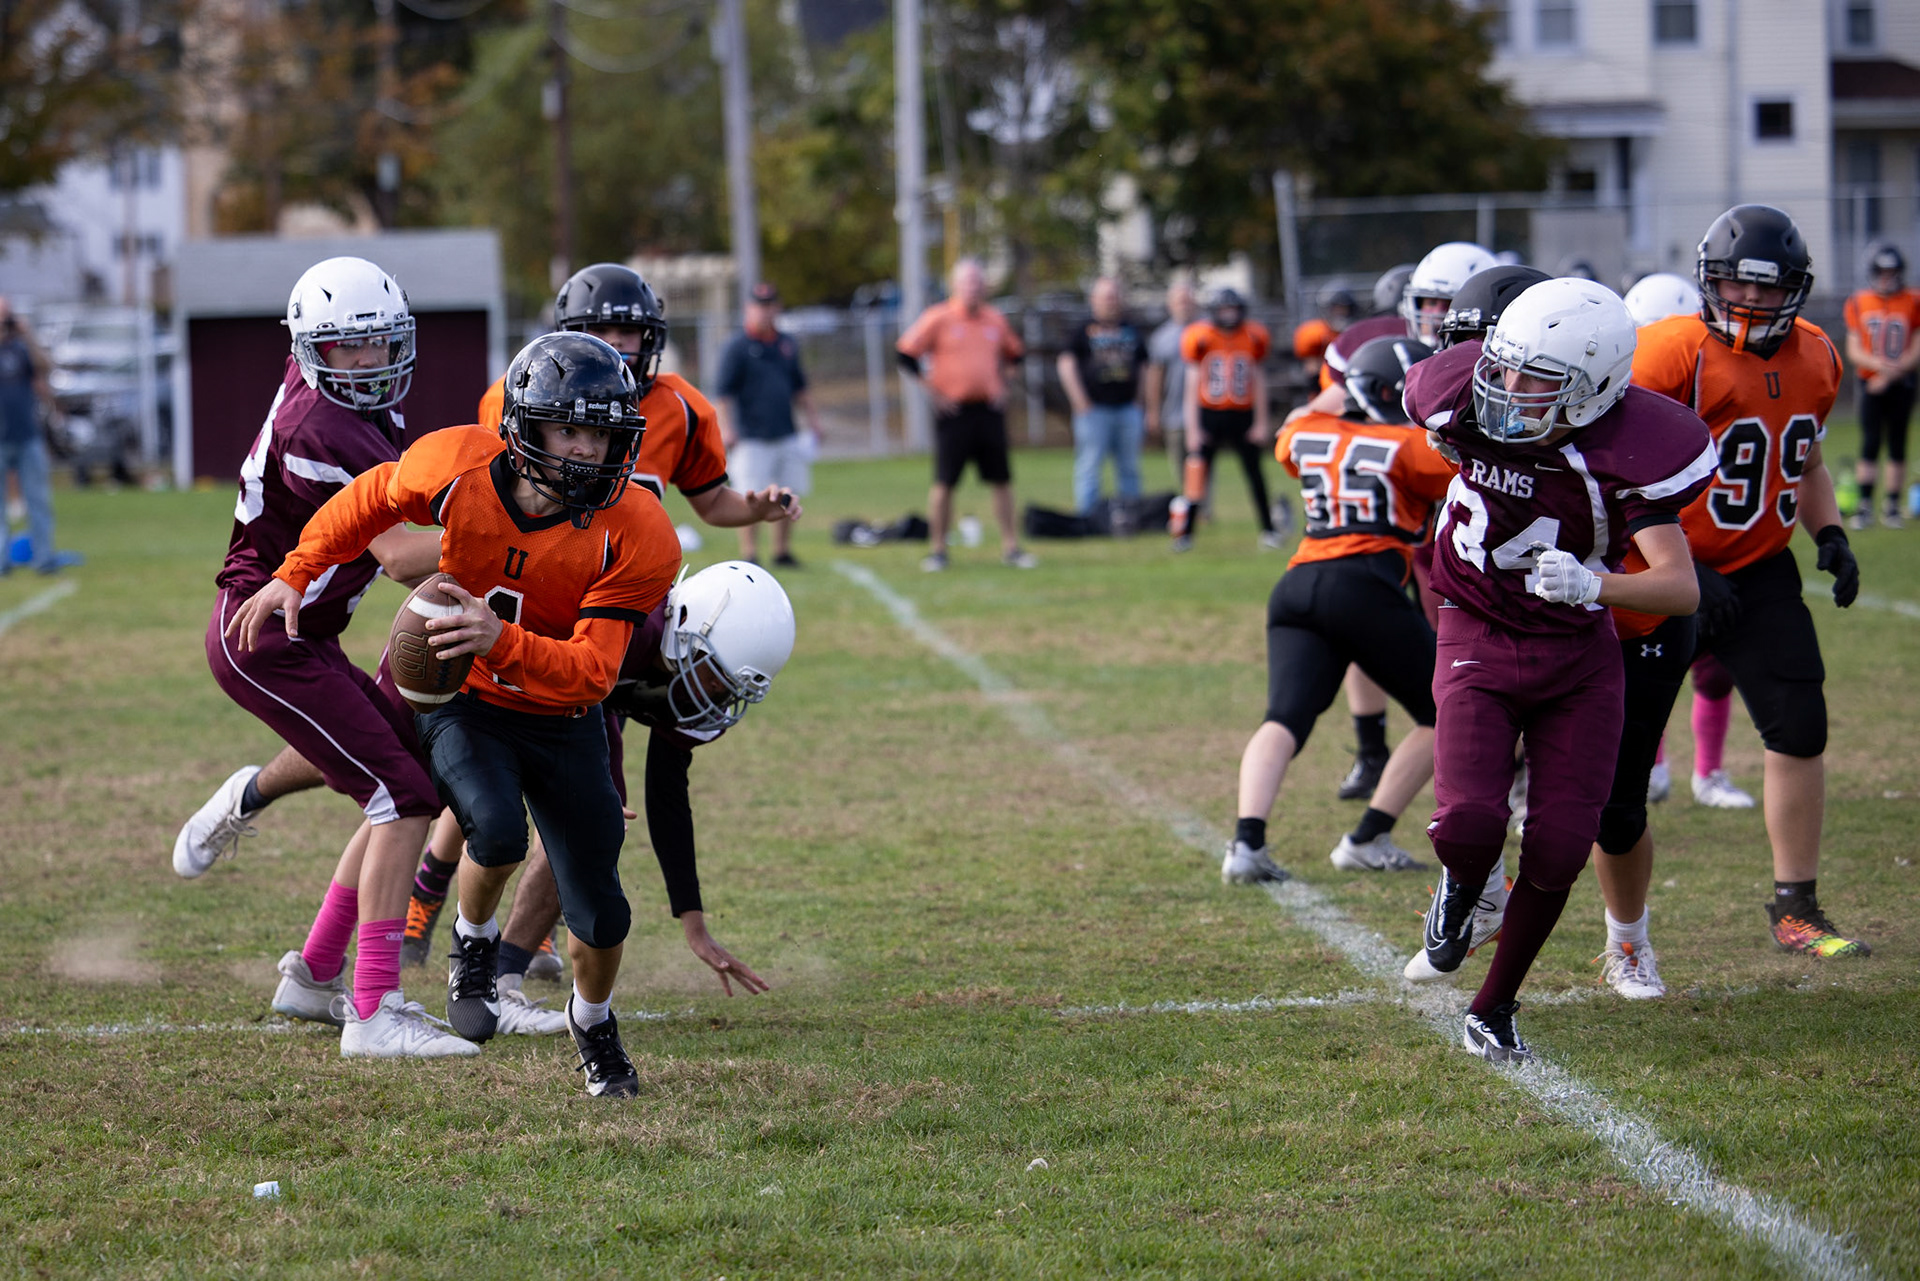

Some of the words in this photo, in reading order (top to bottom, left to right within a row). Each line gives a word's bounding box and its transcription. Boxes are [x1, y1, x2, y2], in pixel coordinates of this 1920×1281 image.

[1764, 372, 1780, 399] U
[1289, 432, 1400, 529] 55
[1469, 458, 1534, 499] RAMS
[1706, 413, 1818, 531] 99
[503, 546, 528, 580] U
